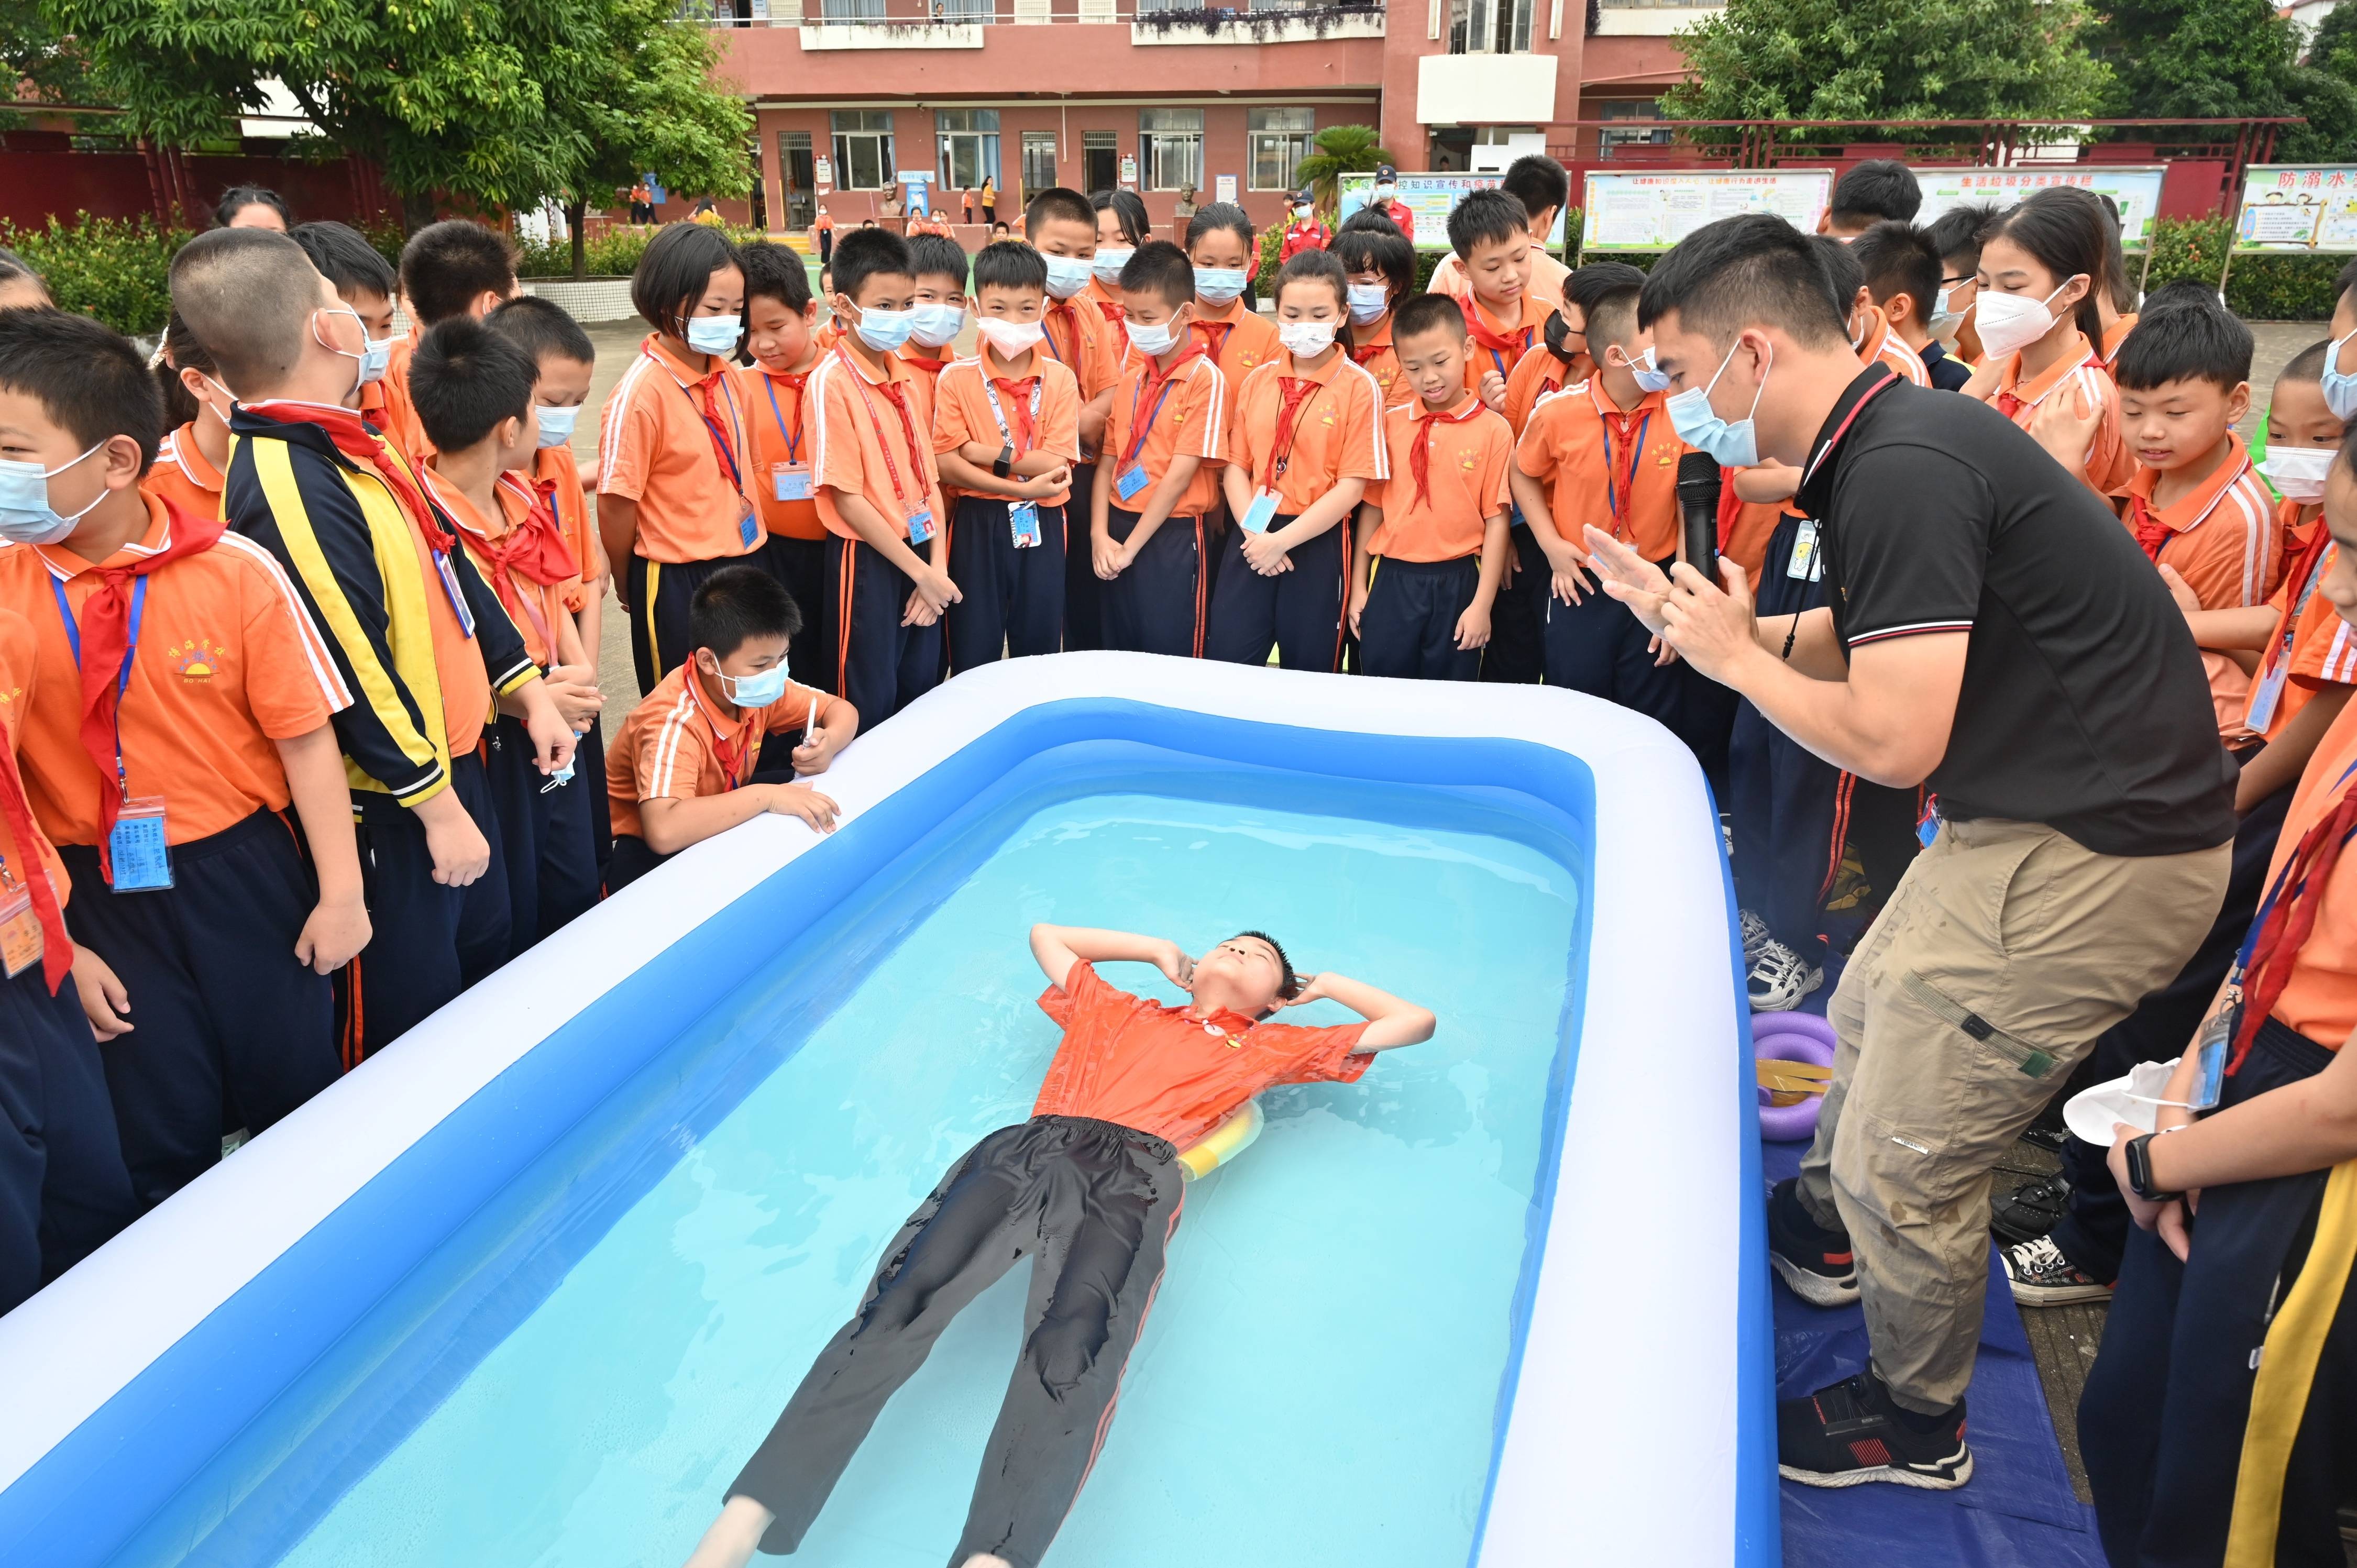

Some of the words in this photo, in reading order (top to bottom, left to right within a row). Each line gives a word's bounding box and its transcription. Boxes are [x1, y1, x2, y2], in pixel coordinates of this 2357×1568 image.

[1961, 175, 2092, 187] 生活垃圾分类宣传栏
[2278, 171, 2357, 188] 防溺水
